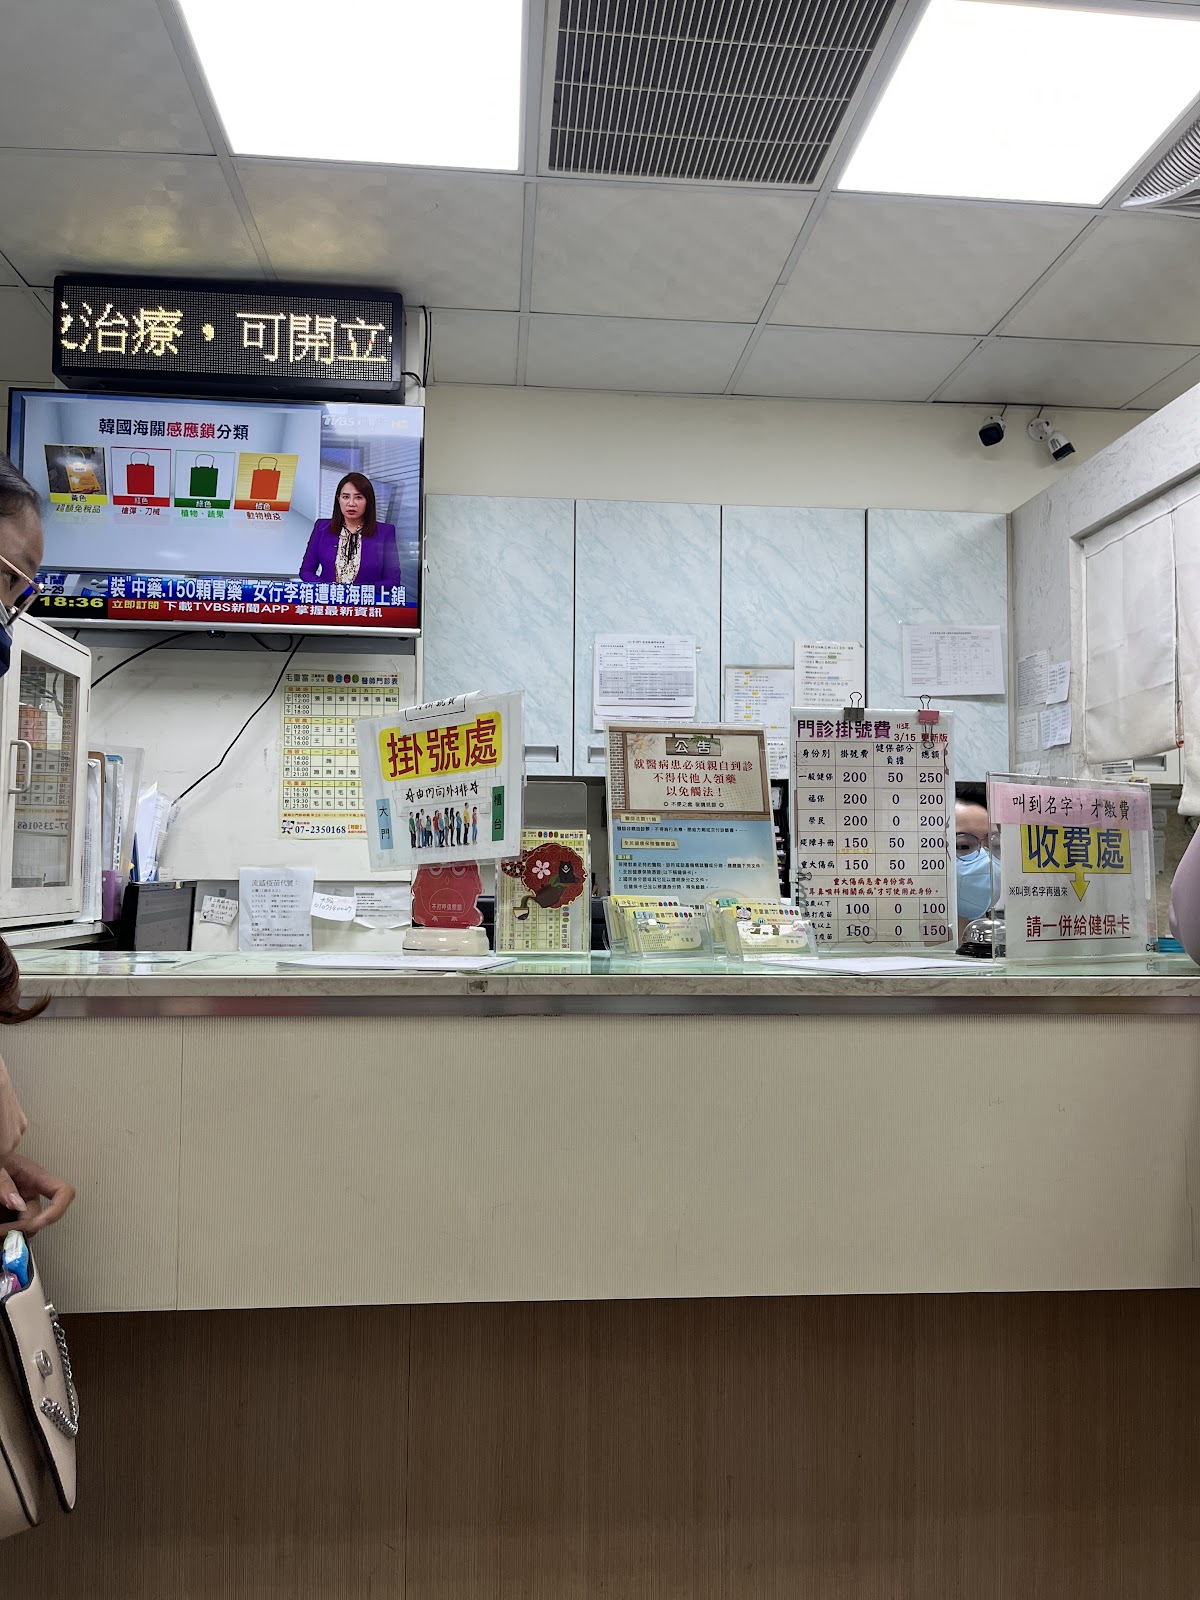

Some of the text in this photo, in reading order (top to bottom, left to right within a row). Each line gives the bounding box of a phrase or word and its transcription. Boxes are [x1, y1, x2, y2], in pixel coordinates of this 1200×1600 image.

[99, 418, 249, 440] 韓國海關感應鎖分類
[71, 494, 87, 502] 黃色
[55, 503, 101, 513] 超額免稅品
[196, 500, 212, 508] 綠色
[246, 511, 281, 521] 動物檢疫
[253, 582, 406, 606] 女行李箱遭韓海關上鎖
[40, 596, 104, 608] 18:36
[112, 600, 383, 618] 立即訂閱 下載TVBS新聞APP 掌握最新資訊
[797, 720, 891, 739] 門診掛號費
[894, 733, 948, 742] 3/15 更新版
[387, 718, 497, 778] 掛號處
[675, 740, 711, 754] 公告
[803, 744, 940, 759] 身份別 掛號費 健保部分 總額
[634, 758, 753, 772] 就醫病患必須親自到診
[887, 756, 904, 765] 負擔
[653, 773, 737, 785] 不得代他人領藥
[798, 772, 943, 783] 一般健保 200 50 250
[666, 786, 722, 797] 以免觸法！
[808, 794, 944, 805] 福保 200 0 200
[379, 805, 391, 840] 大門
[809, 816, 944, 827] 榮民 200 0 200
[295, 826, 346, 834] 07-2350168
[845, 837, 868, 848] 150
[889, 837, 905, 848] 50
[920, 837, 945, 848] 200
[1027, 825, 1125, 869] 收費處
[801, 859, 945, 870] 重大傷病 150 50 200
[833, 877, 914, 886] 重大傷病患者身份需為
[846, 904, 869, 915] 100
[895, 904, 902, 915] 0
[923, 904, 946, 915] 100
[846, 926, 870, 936] 150
[895, 926, 902, 936] 0
[923, 926, 946, 936] 150
[1026, 914, 1130, 938] 請一併給健保卡
